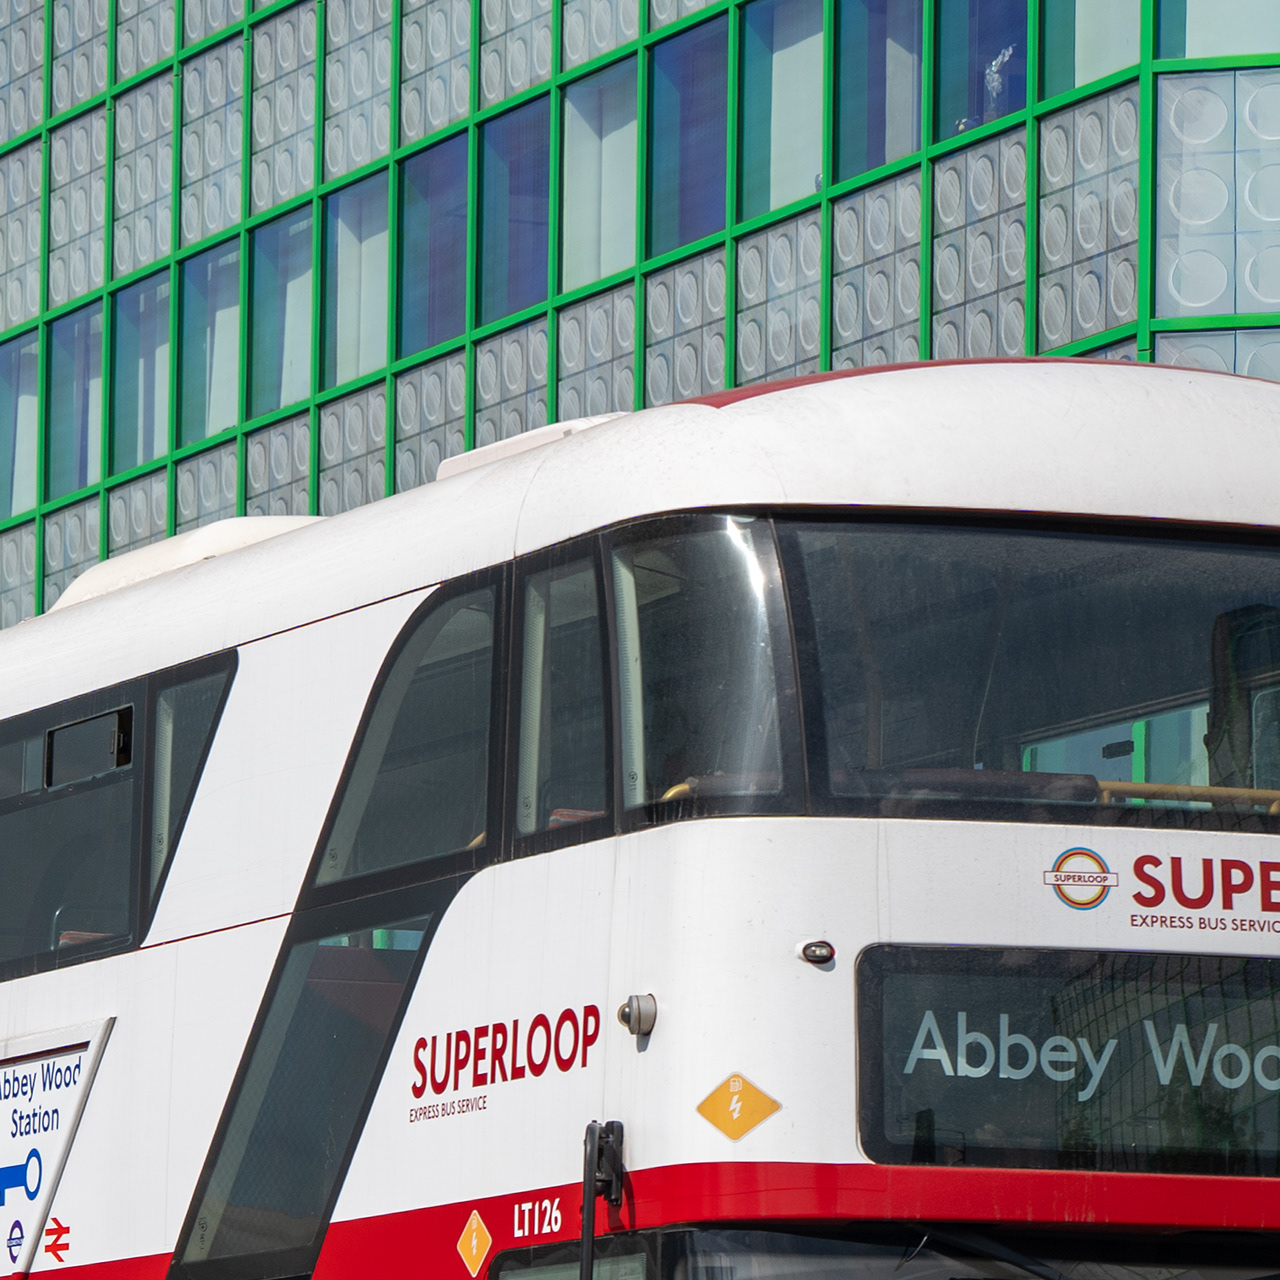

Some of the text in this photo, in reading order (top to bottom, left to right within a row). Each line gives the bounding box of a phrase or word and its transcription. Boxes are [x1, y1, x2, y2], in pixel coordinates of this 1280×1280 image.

[1053, 873, 1108, 884] SUPERLOOP
[1130, 914, 1194, 930] EXPRESS
[1198, 917, 1227, 931] BUS
[411, 1004, 600, 1099] SUPERLOOP
[904, 1010, 1117, 1103] Abbey
[41, 1055, 82, 1092] Wood
[10, 1105, 60, 1138] Station
[409, 1095, 487, 1123] EXPRESS BUS SERVICE
[513, 1198, 562, 1239] LT126
